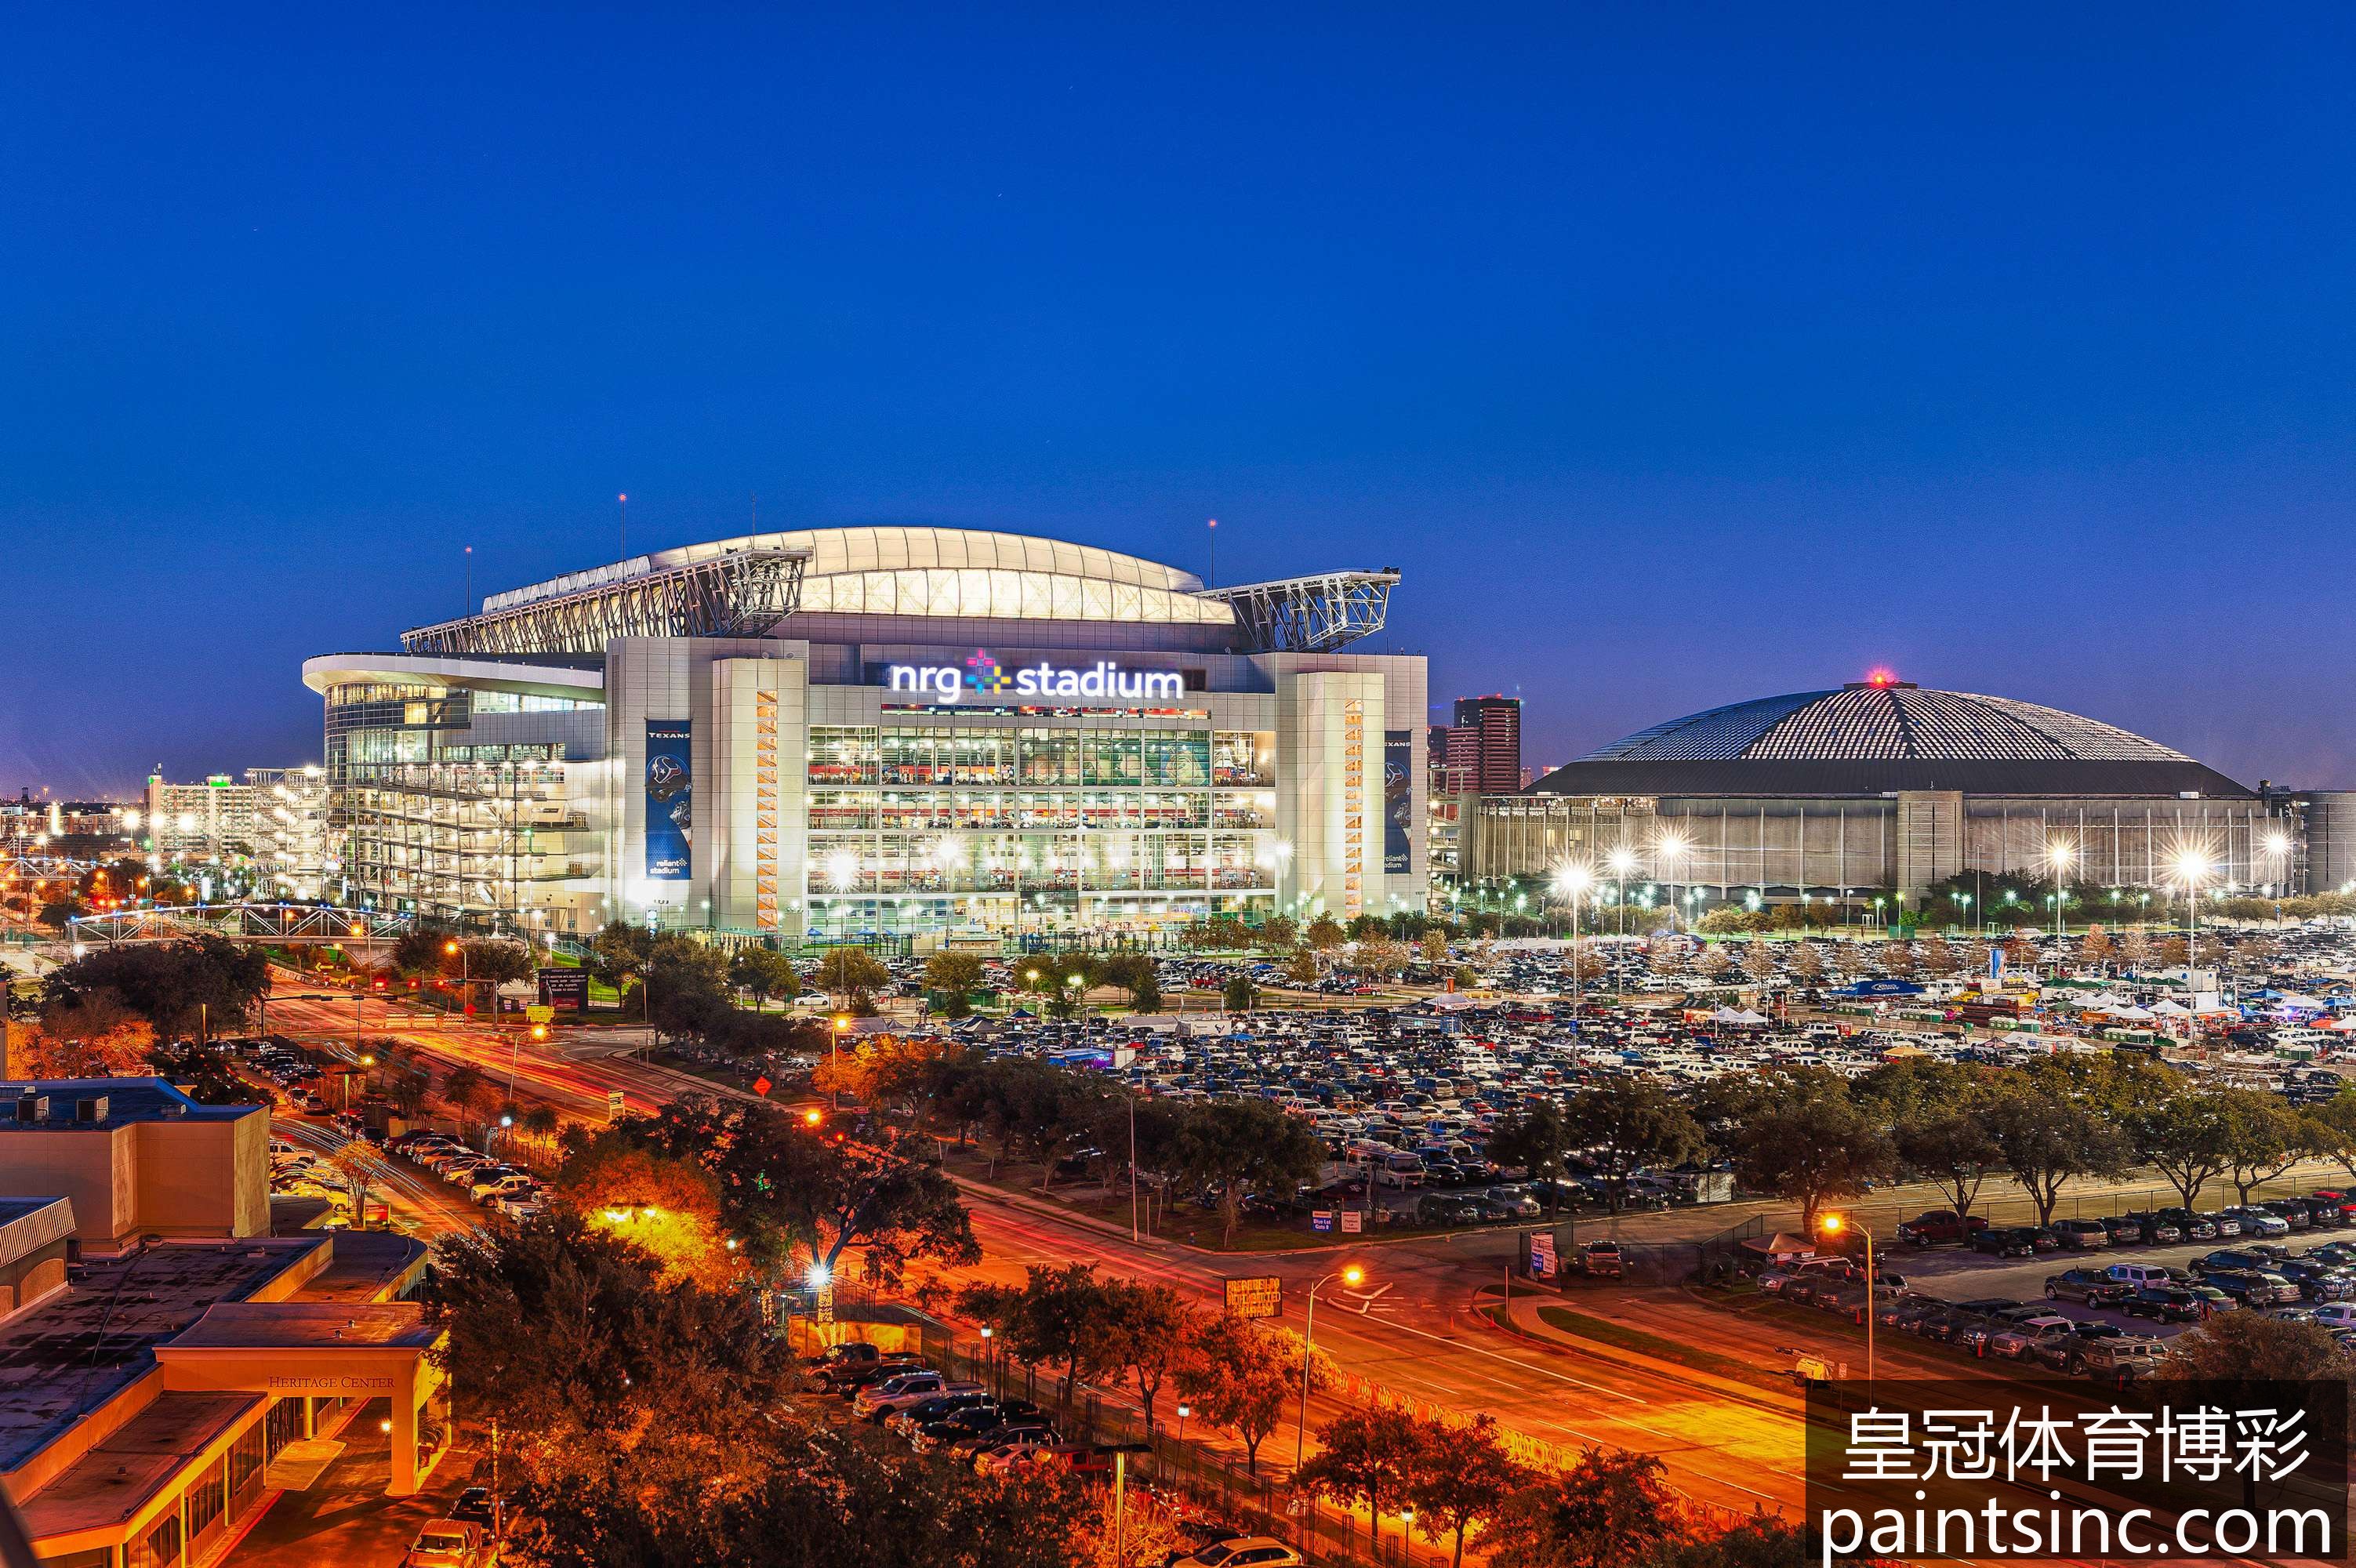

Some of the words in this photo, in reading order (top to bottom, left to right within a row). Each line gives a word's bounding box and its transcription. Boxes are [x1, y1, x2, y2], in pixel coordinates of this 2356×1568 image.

[891, 665, 962, 704] nrg
[1015, 661, 1185, 699] stadium
[269, 1376, 338, 1388] HERITAGE
[341, 1376, 395, 1388] CENTER
